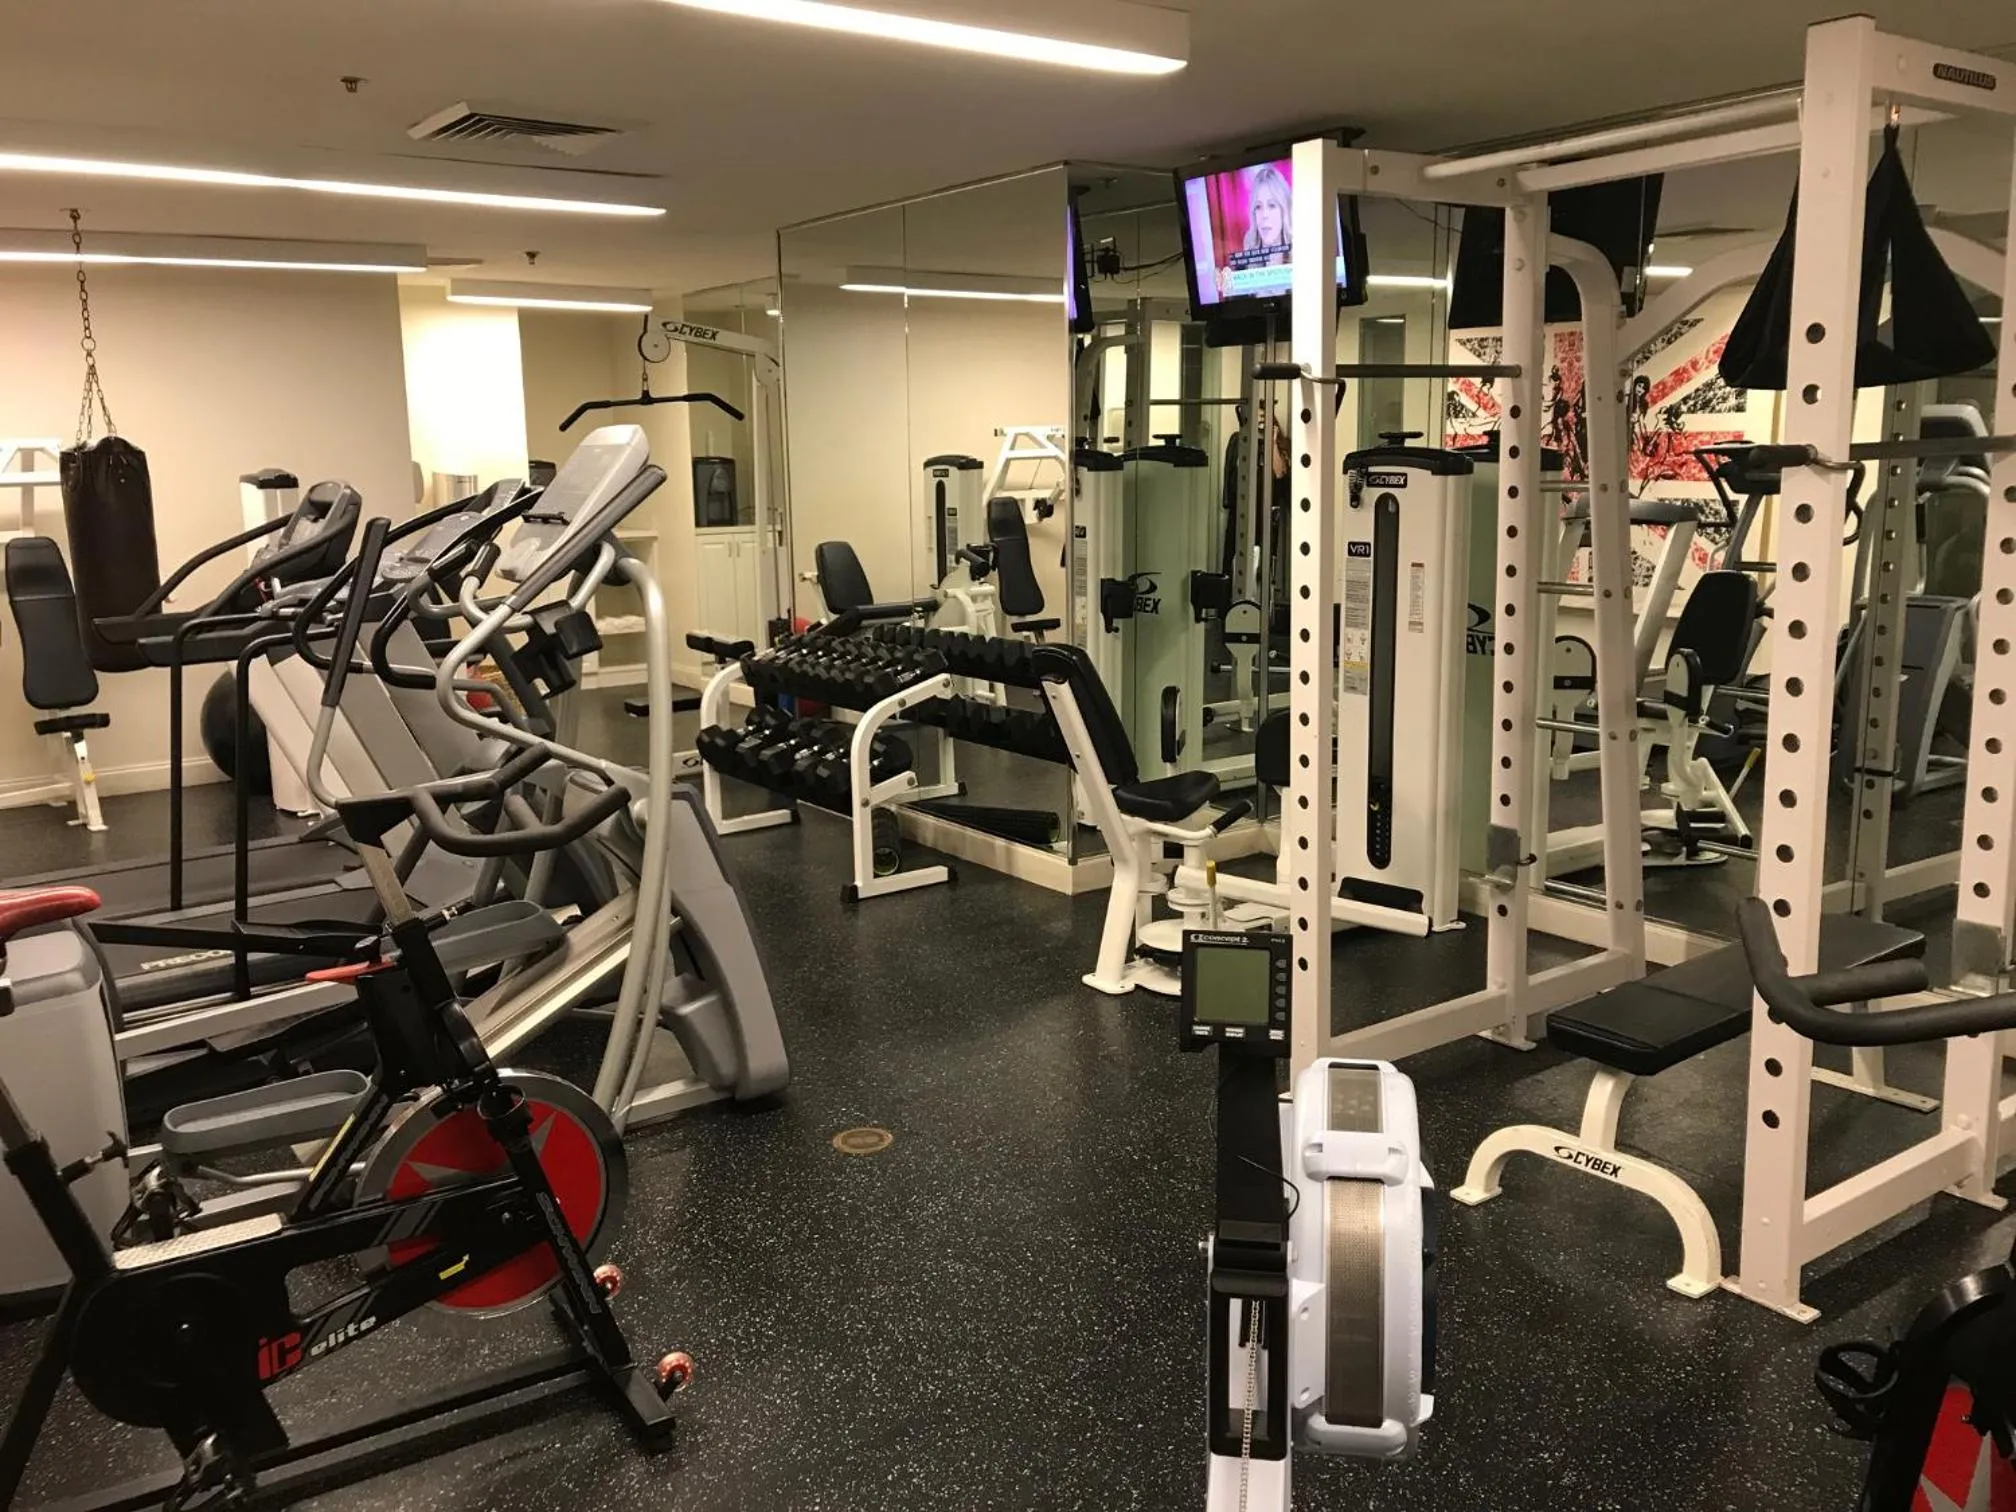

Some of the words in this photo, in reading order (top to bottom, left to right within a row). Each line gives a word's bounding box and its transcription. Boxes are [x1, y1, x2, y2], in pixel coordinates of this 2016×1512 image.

[679, 322, 720, 342] CYBEX
[1350, 543, 1370, 556] VR1
[1135, 596, 1162, 615] BEX
[1573, 1151, 1622, 1178] CYBEX
[310, 1315, 377, 1356] elite
